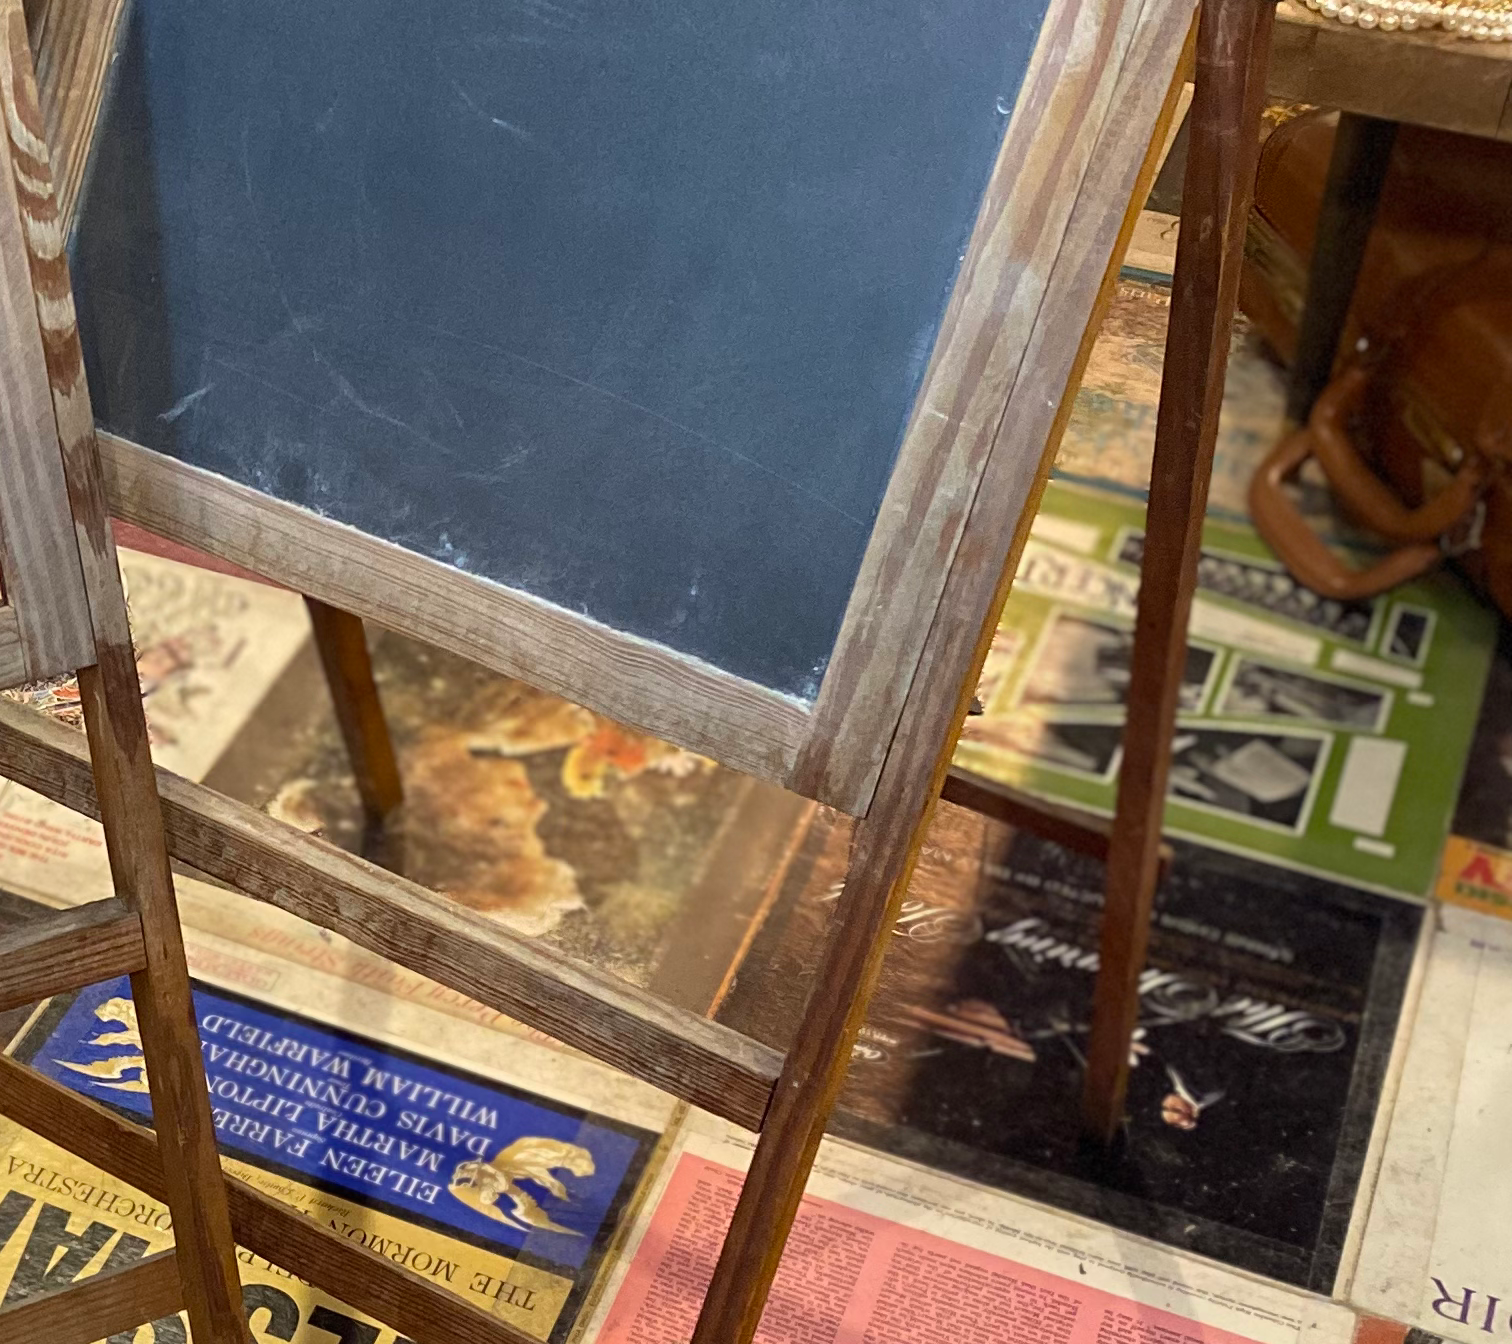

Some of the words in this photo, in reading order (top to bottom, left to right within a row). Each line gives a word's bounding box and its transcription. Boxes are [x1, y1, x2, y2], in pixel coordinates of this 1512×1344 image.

[246, 927, 340, 974] Strings
[353, 959, 416, 998] Faith
[201, 1011, 349, 1082] WARFIELD
[193, 1037, 385, 1118] CUNNINGHA
[198, 1071, 302, 1122] LIPTON
[363, 1065, 497, 1128] WILLIAM
[211, 1106, 309, 1157] FARRE
[316, 1107, 442, 1172] MARTHA
[397, 1109, 490, 1160] DAVIS
[7, 1154, 174, 1231] ORCHESTRA
[320, 1147, 440, 1204] EILEEN
[469, 1271, 535, 1310] THE
